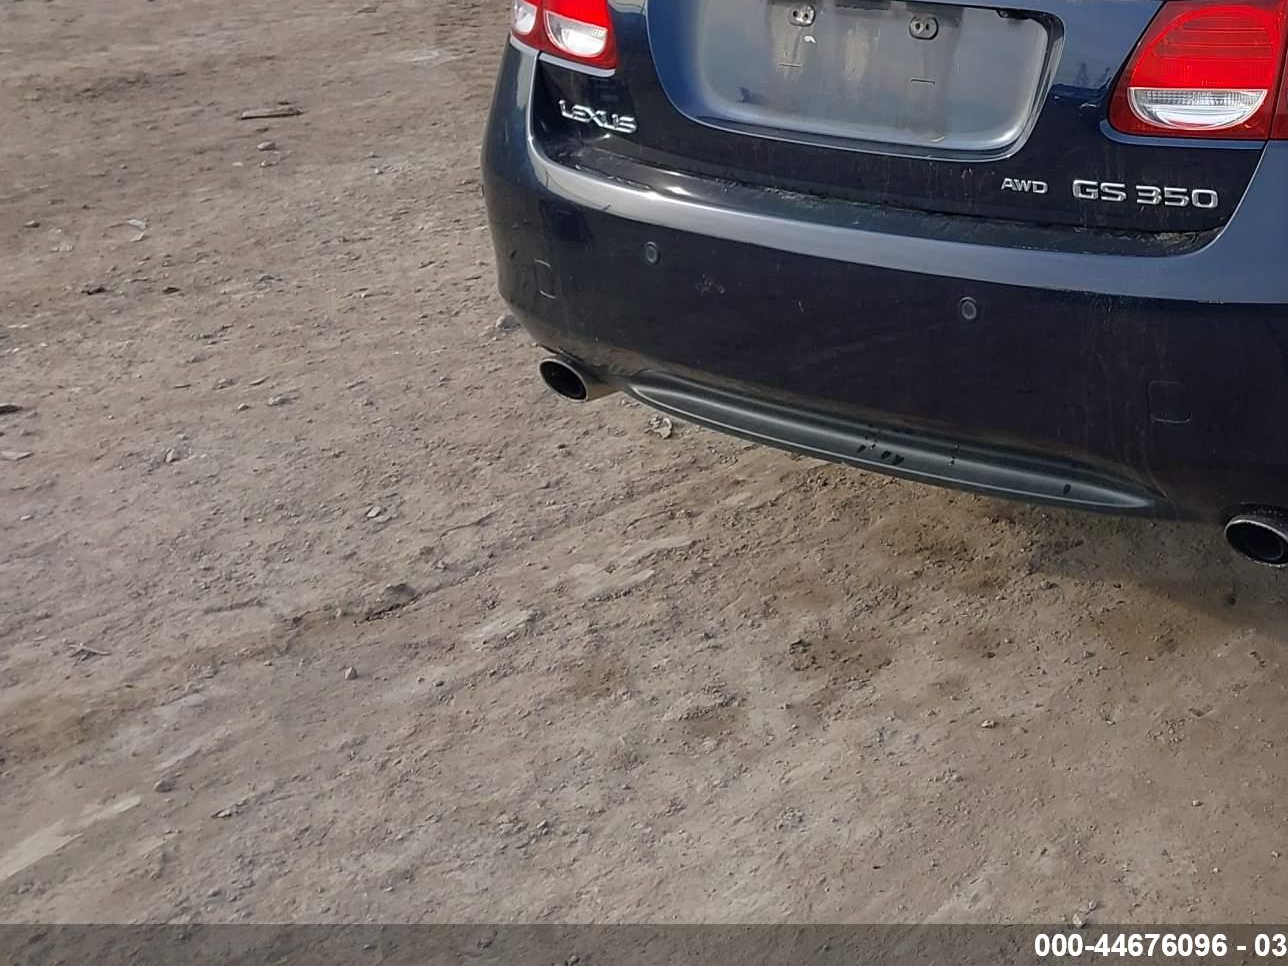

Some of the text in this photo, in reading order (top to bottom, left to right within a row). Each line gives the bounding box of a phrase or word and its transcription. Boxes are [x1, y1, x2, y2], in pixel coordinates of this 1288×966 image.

[559, 99, 637, 134] LEXUS
[1001, 177, 1048, 194] AWD
[1072, 179, 1219, 209] GS 350
